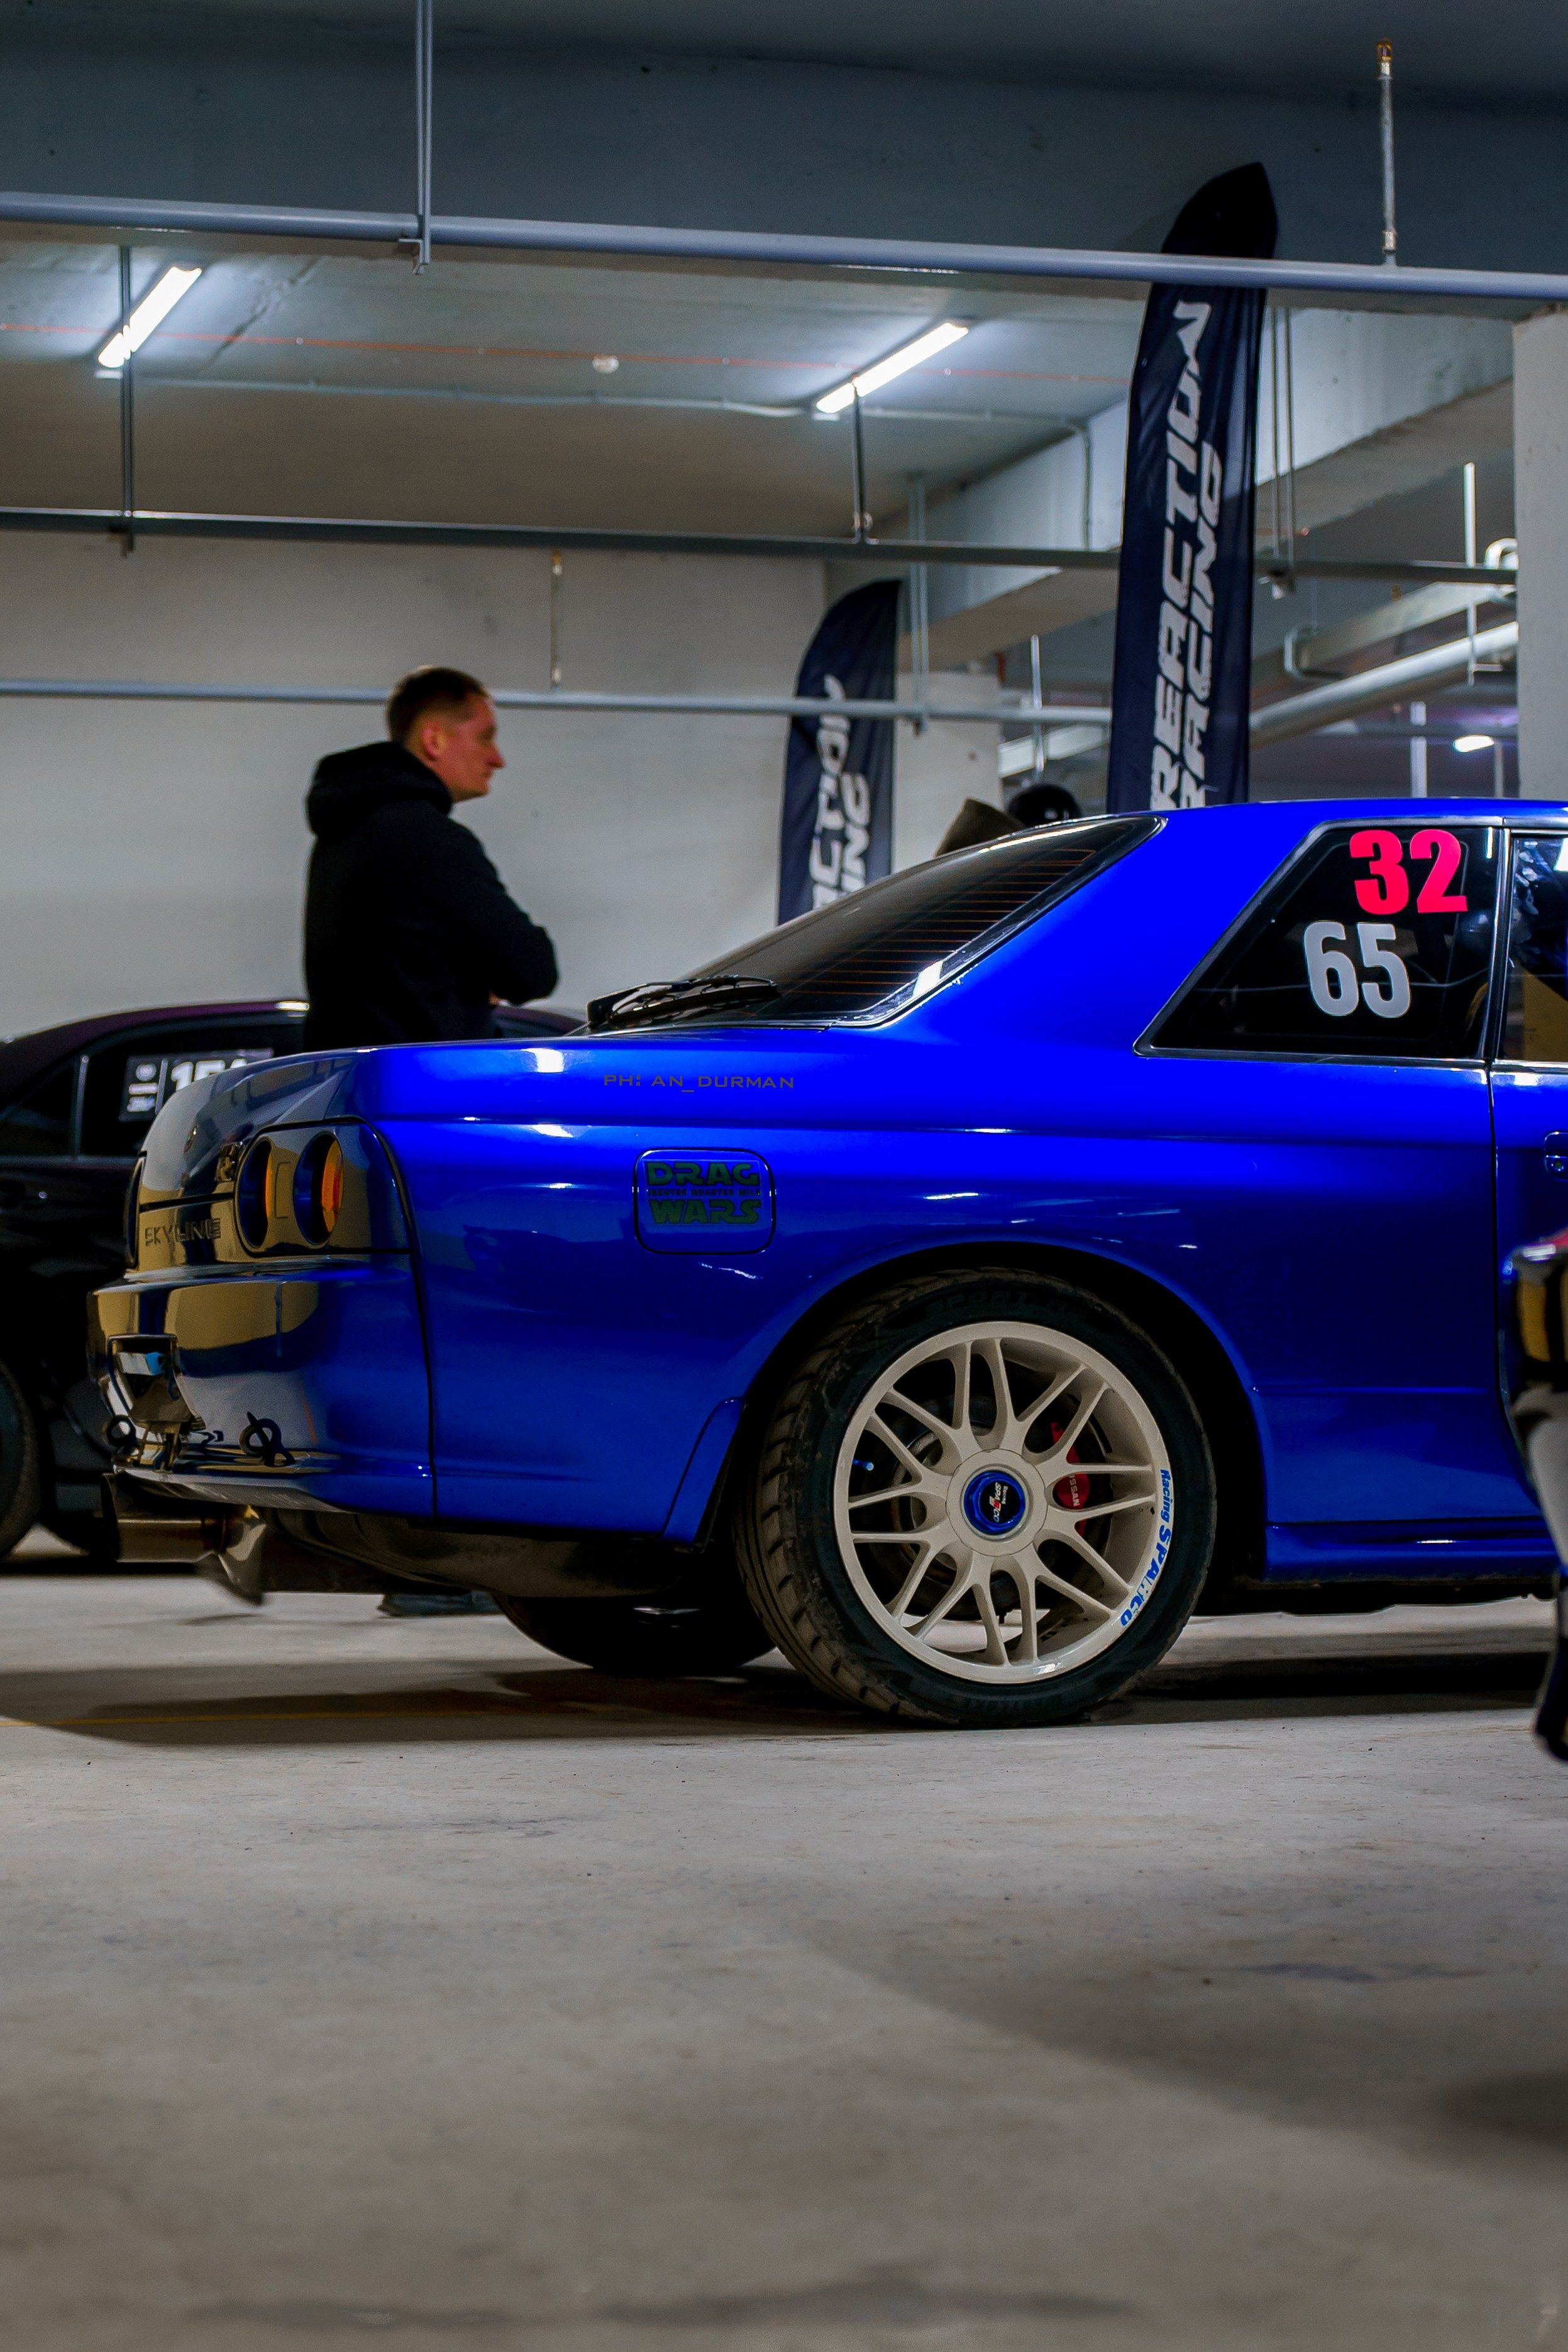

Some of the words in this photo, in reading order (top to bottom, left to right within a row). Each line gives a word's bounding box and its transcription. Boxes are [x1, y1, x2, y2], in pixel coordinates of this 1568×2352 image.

[1150, 301, 1212, 810] REACTION
[1349, 829, 1468, 915] 32
[1303, 920, 1411, 1019] 65
[646, 1161, 761, 1186] DRAG
[145, 1217, 221, 1247] SKYLINE
[648, 1198, 761, 1224] WARS
[1069, 1474, 1080, 1506] ISSAN
[1161, 1469, 1171, 1523] Racing
